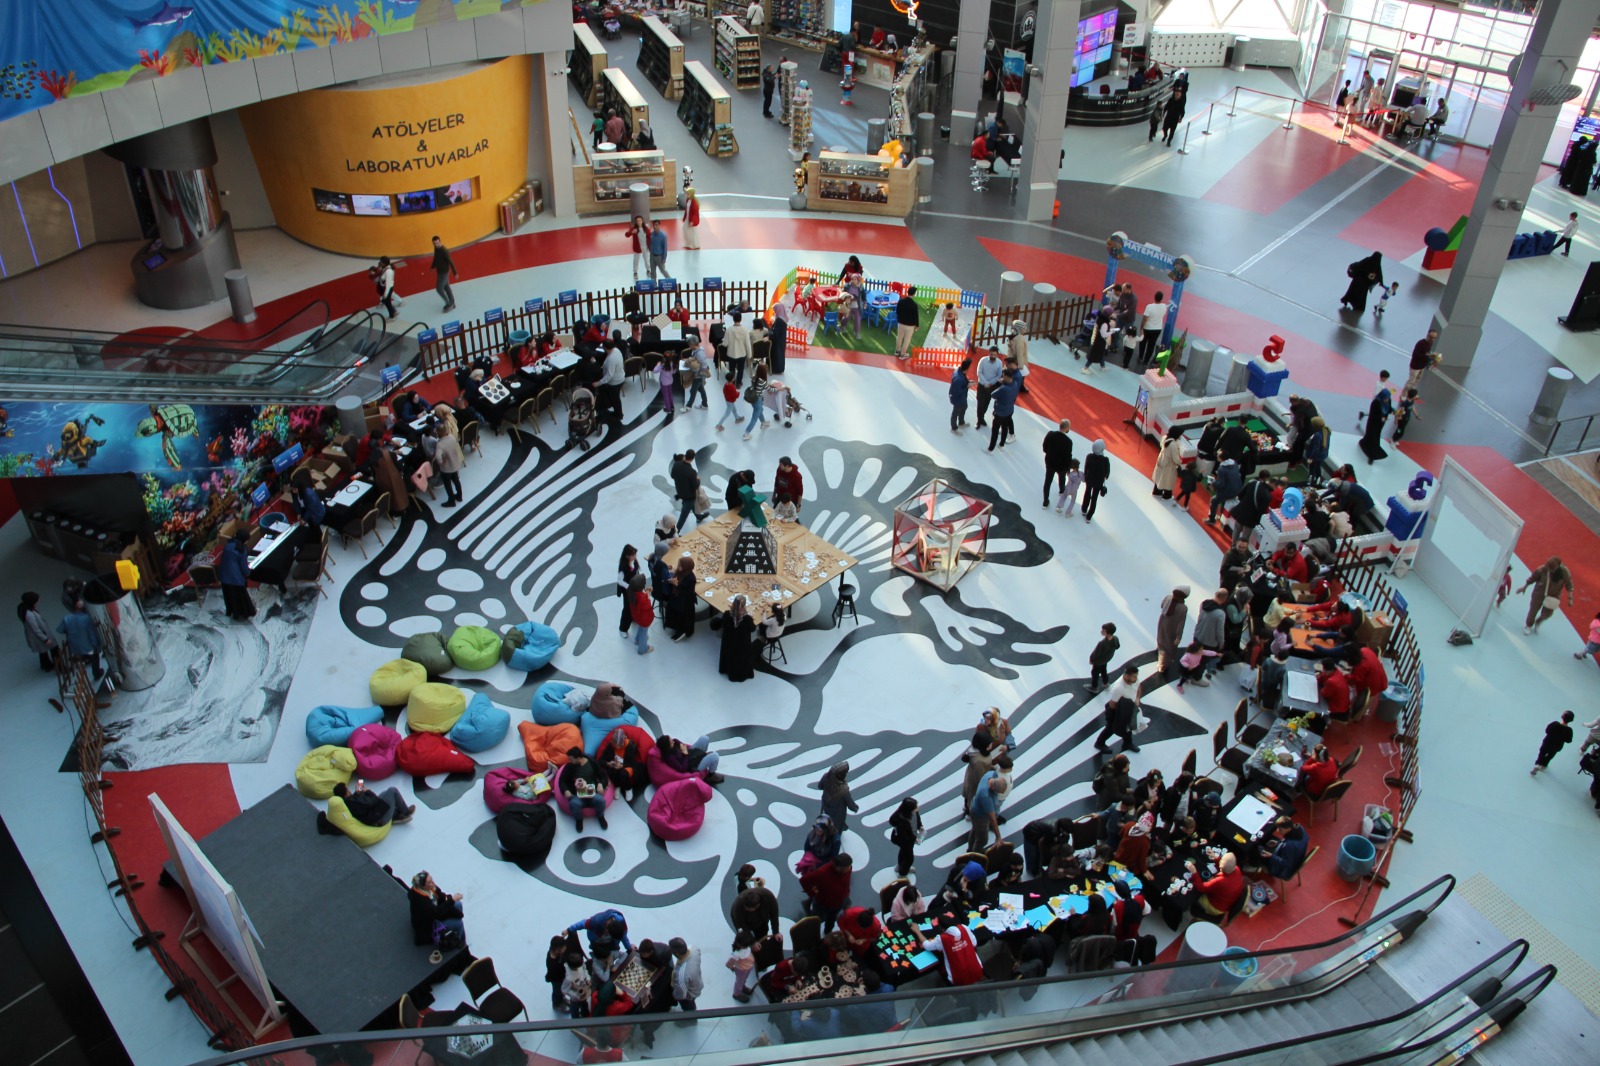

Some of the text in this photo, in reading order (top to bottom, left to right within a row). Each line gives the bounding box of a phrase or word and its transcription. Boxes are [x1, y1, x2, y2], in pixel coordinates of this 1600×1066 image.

[372, 113, 465, 138] ATÖLYELER
[346, 139, 489, 173] LABORATUVARLAR
[416, 139, 428, 152] &
[1123, 240, 1175, 265] MATEMATİK
